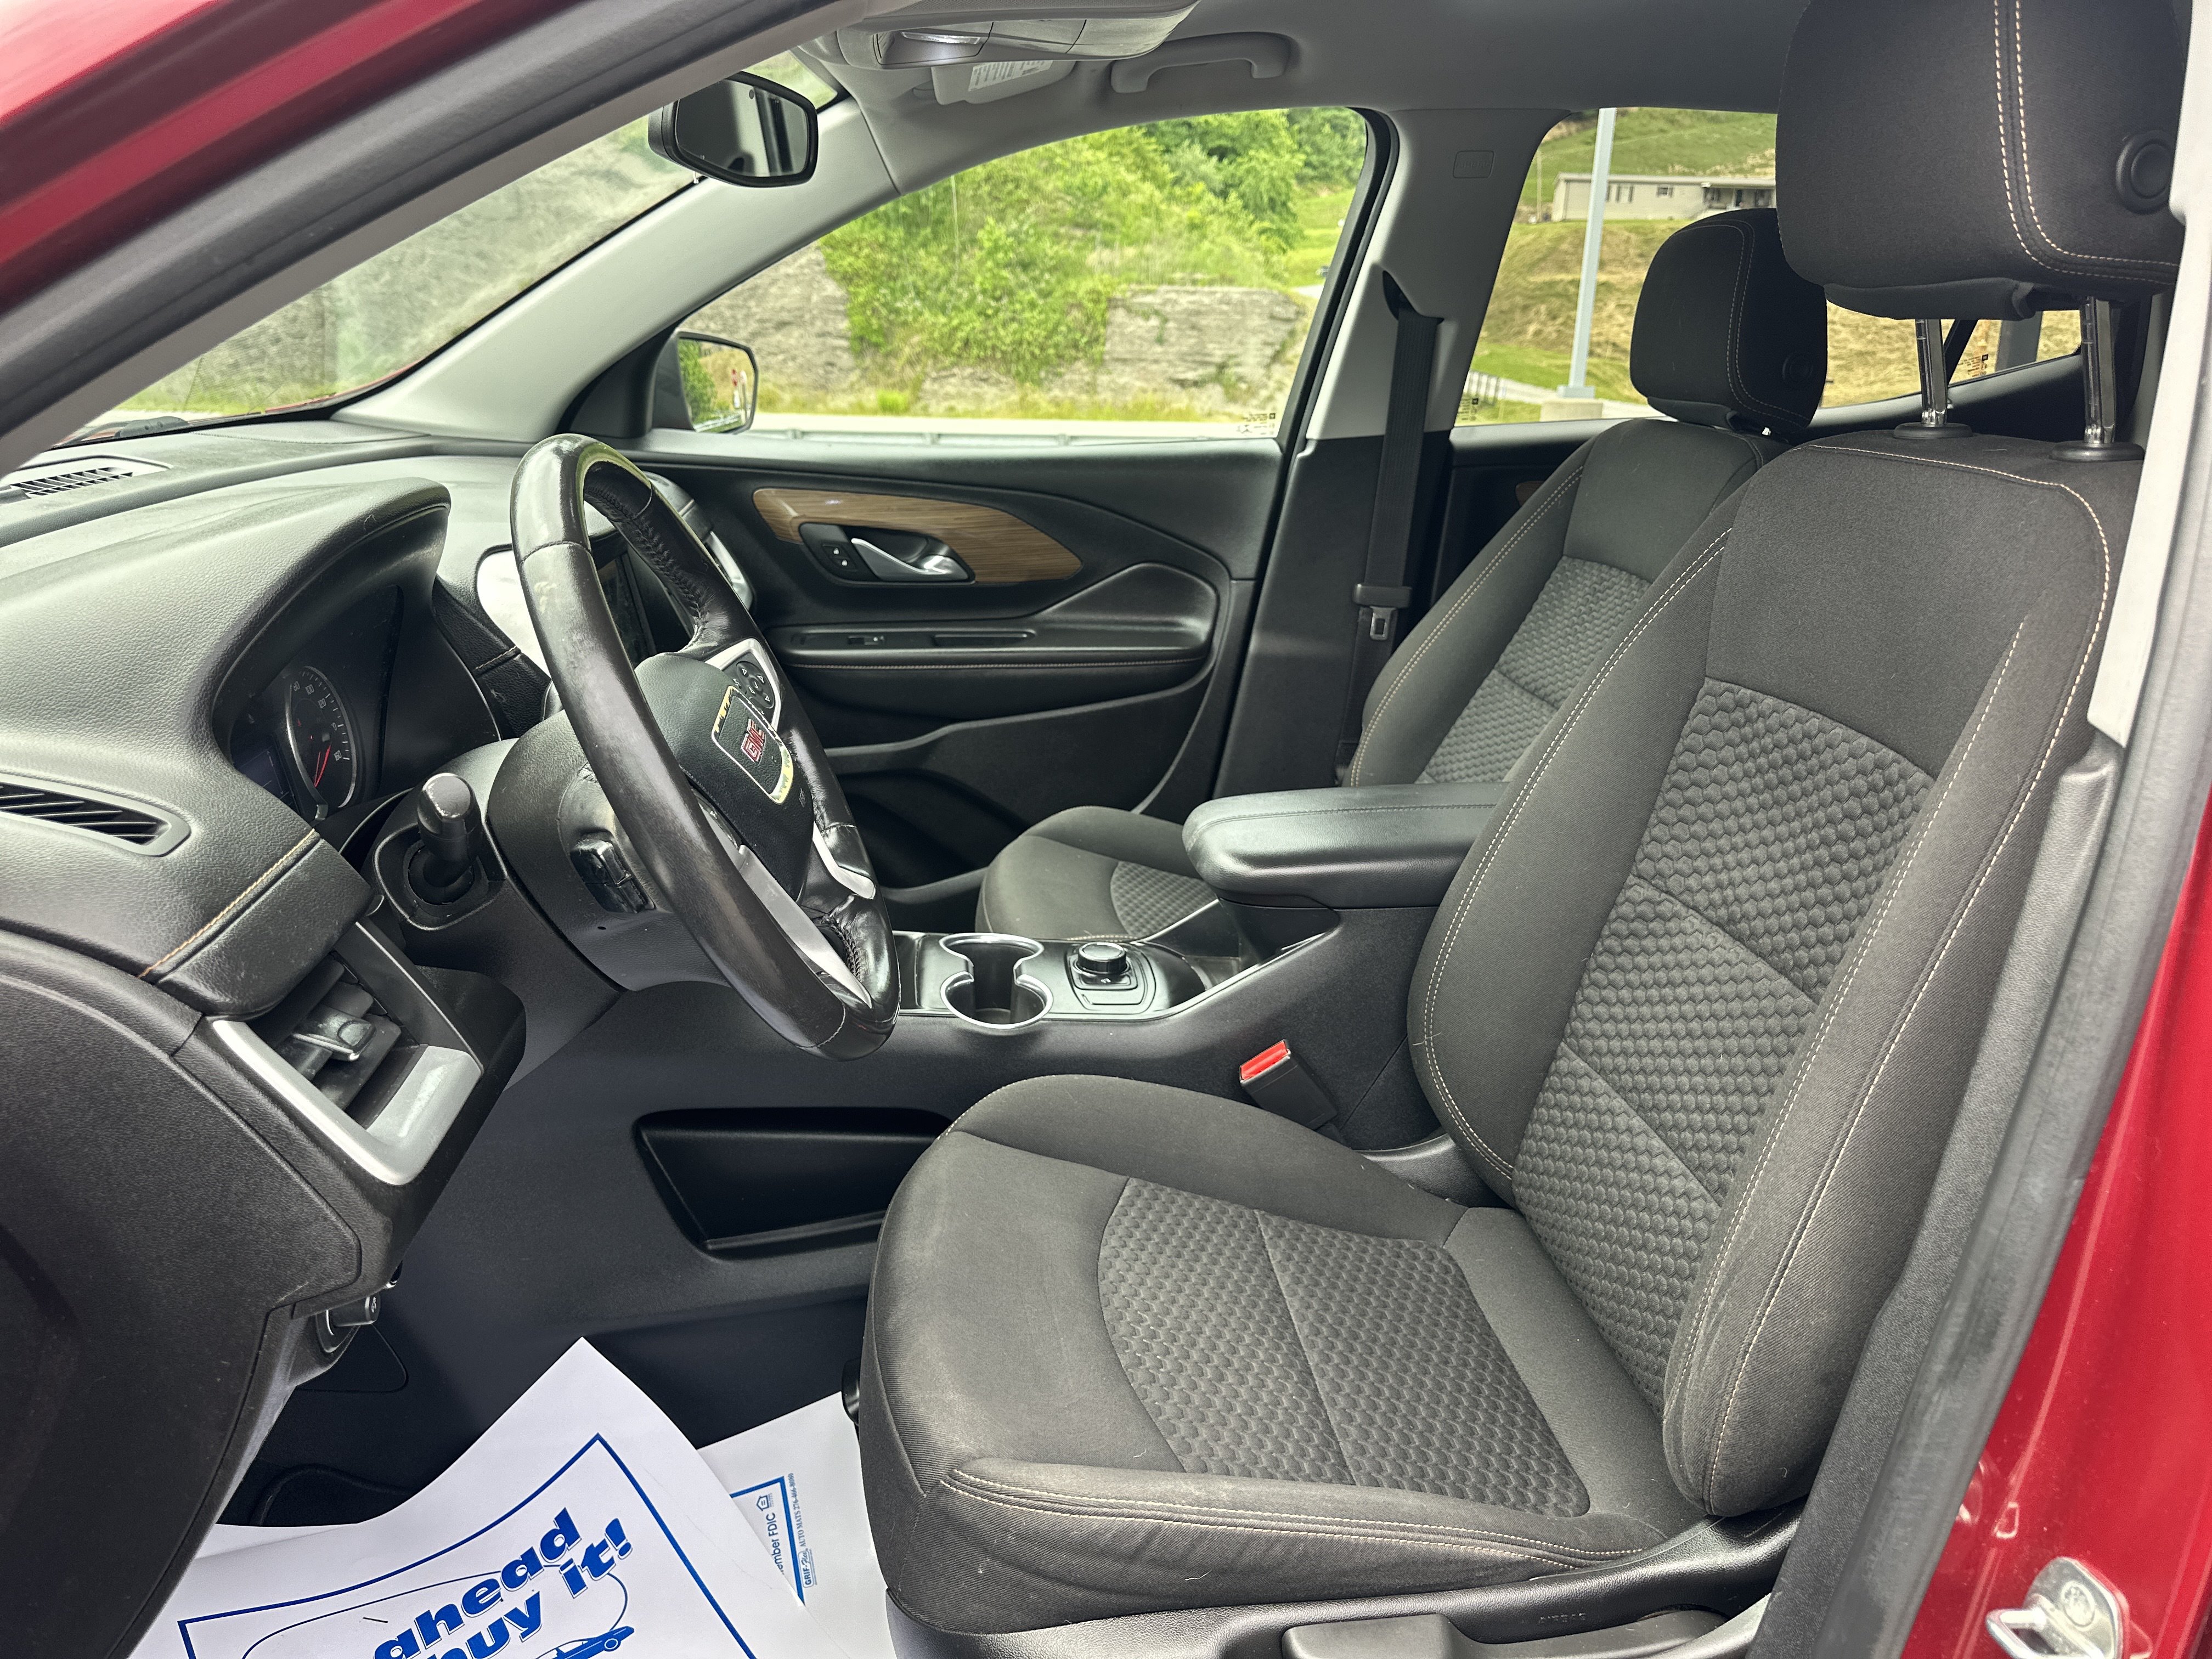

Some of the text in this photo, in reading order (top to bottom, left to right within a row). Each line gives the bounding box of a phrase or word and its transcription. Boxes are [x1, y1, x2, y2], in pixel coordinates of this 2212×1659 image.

[741, 718, 765, 763] GMC
[766, 1513, 778, 1537] FDIC
[794, 1510, 803, 1529] MATS
[797, 1530, 806, 1547] AUTO
[560, 1518, 633, 1599] it!
[771, 1539, 785, 1575] ember
[373, 1507, 582, 1659] ahead
